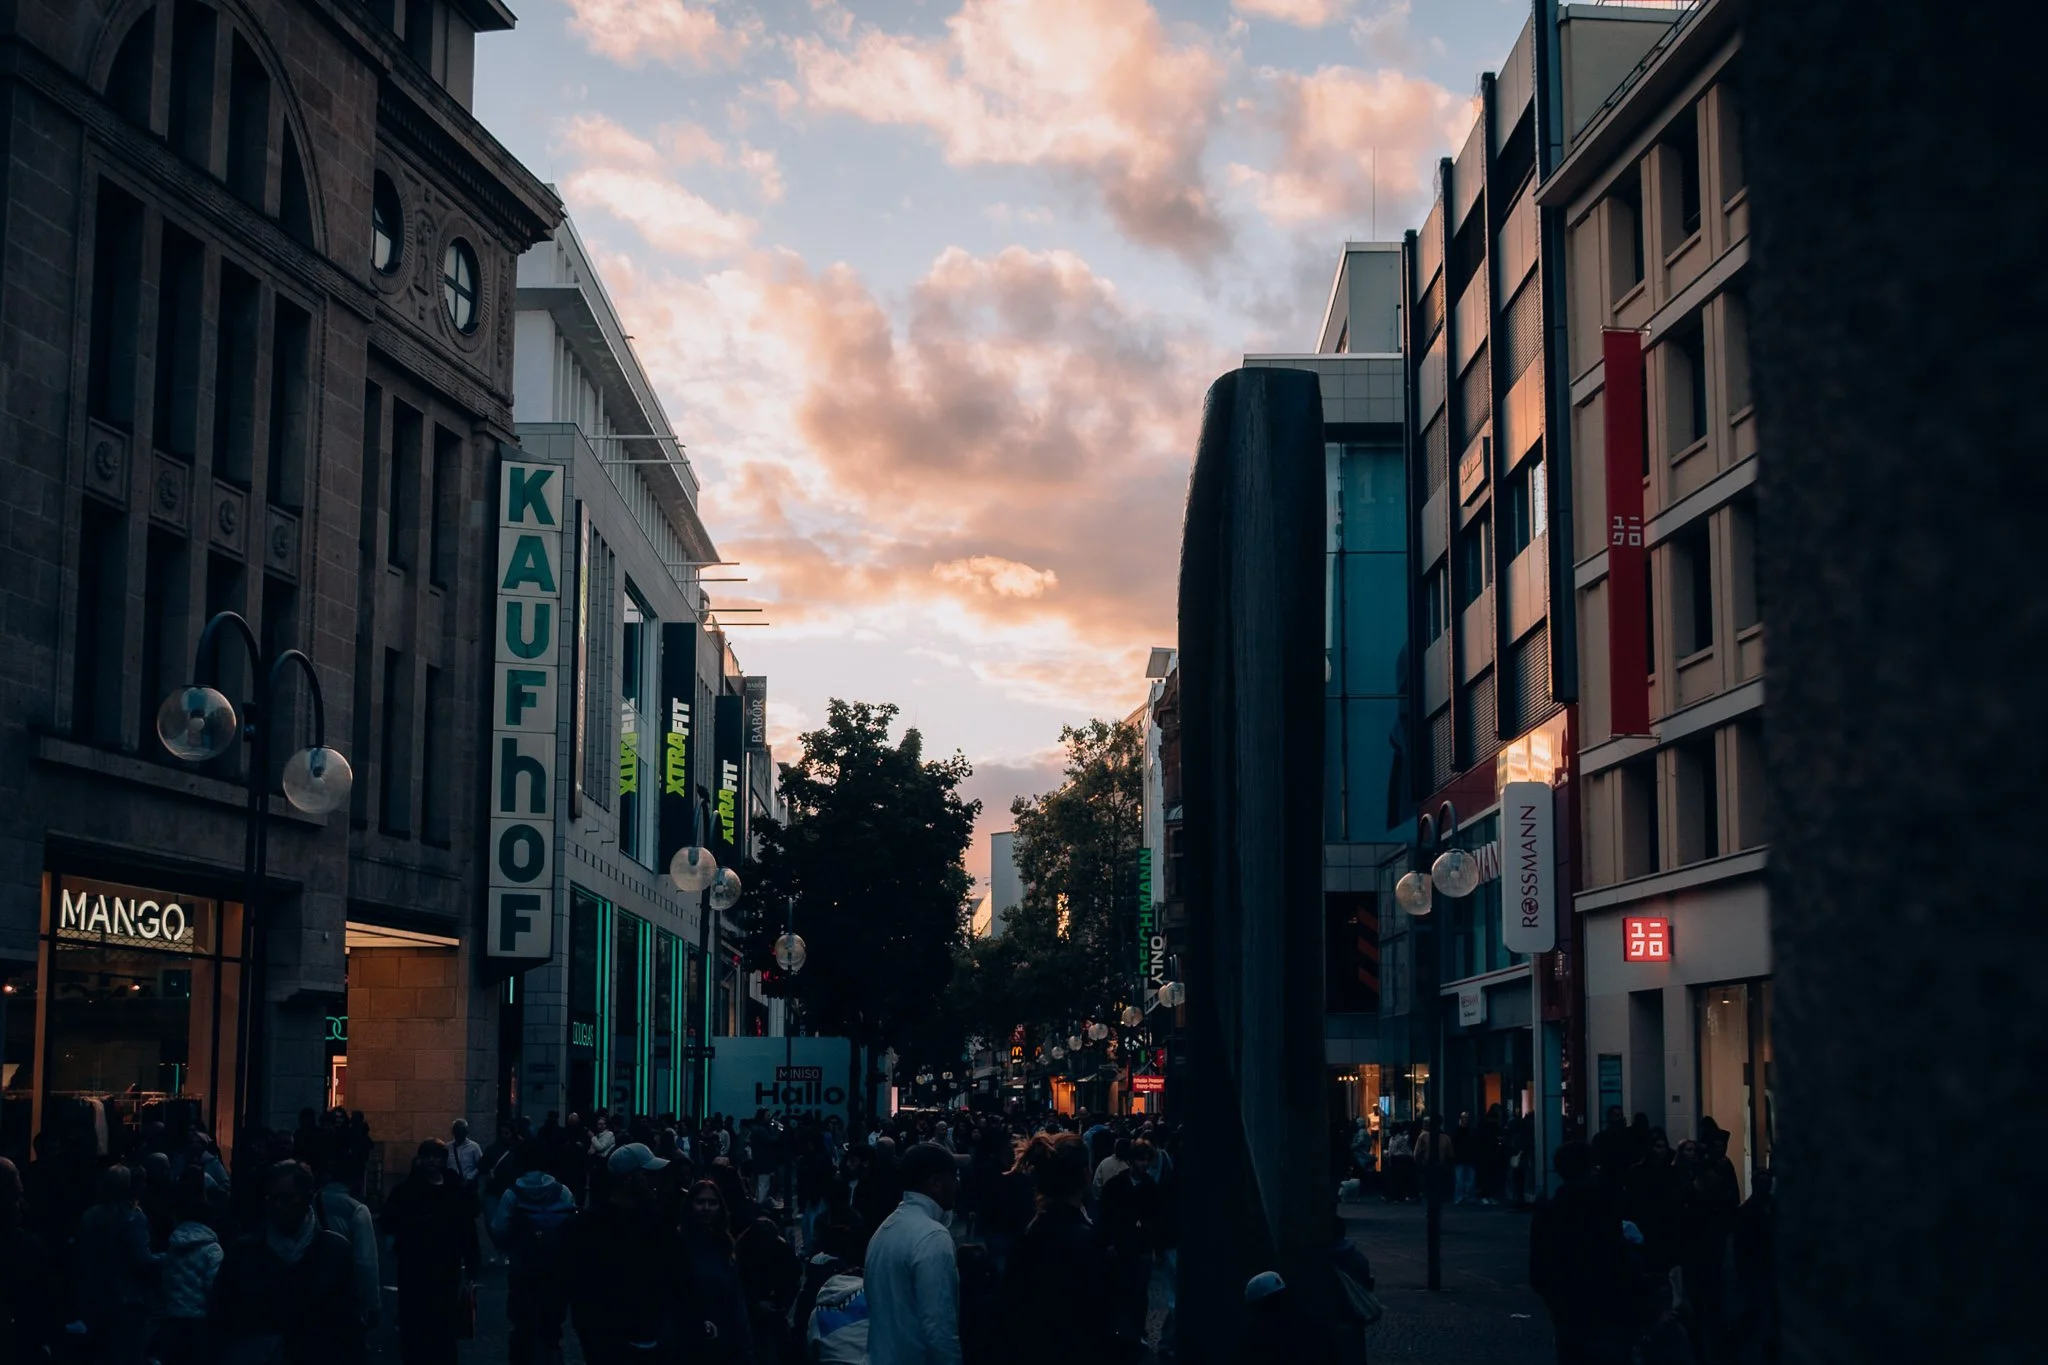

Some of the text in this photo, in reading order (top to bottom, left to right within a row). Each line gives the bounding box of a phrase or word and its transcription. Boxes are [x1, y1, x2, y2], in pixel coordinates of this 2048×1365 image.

[498, 467, 557, 951] KAUFhOF
[752, 698, 764, 742] BABOR
[666, 697, 690, 797] XTRAFIT
[1520, 805, 1538, 928] ROSSMANN
[60, 888, 186, 941] MANGO
[1151, 935, 1164, 985] ONLY
[756, 1082, 845, 1104] Hallo
[779, 1069, 820, 1079] MINISO
